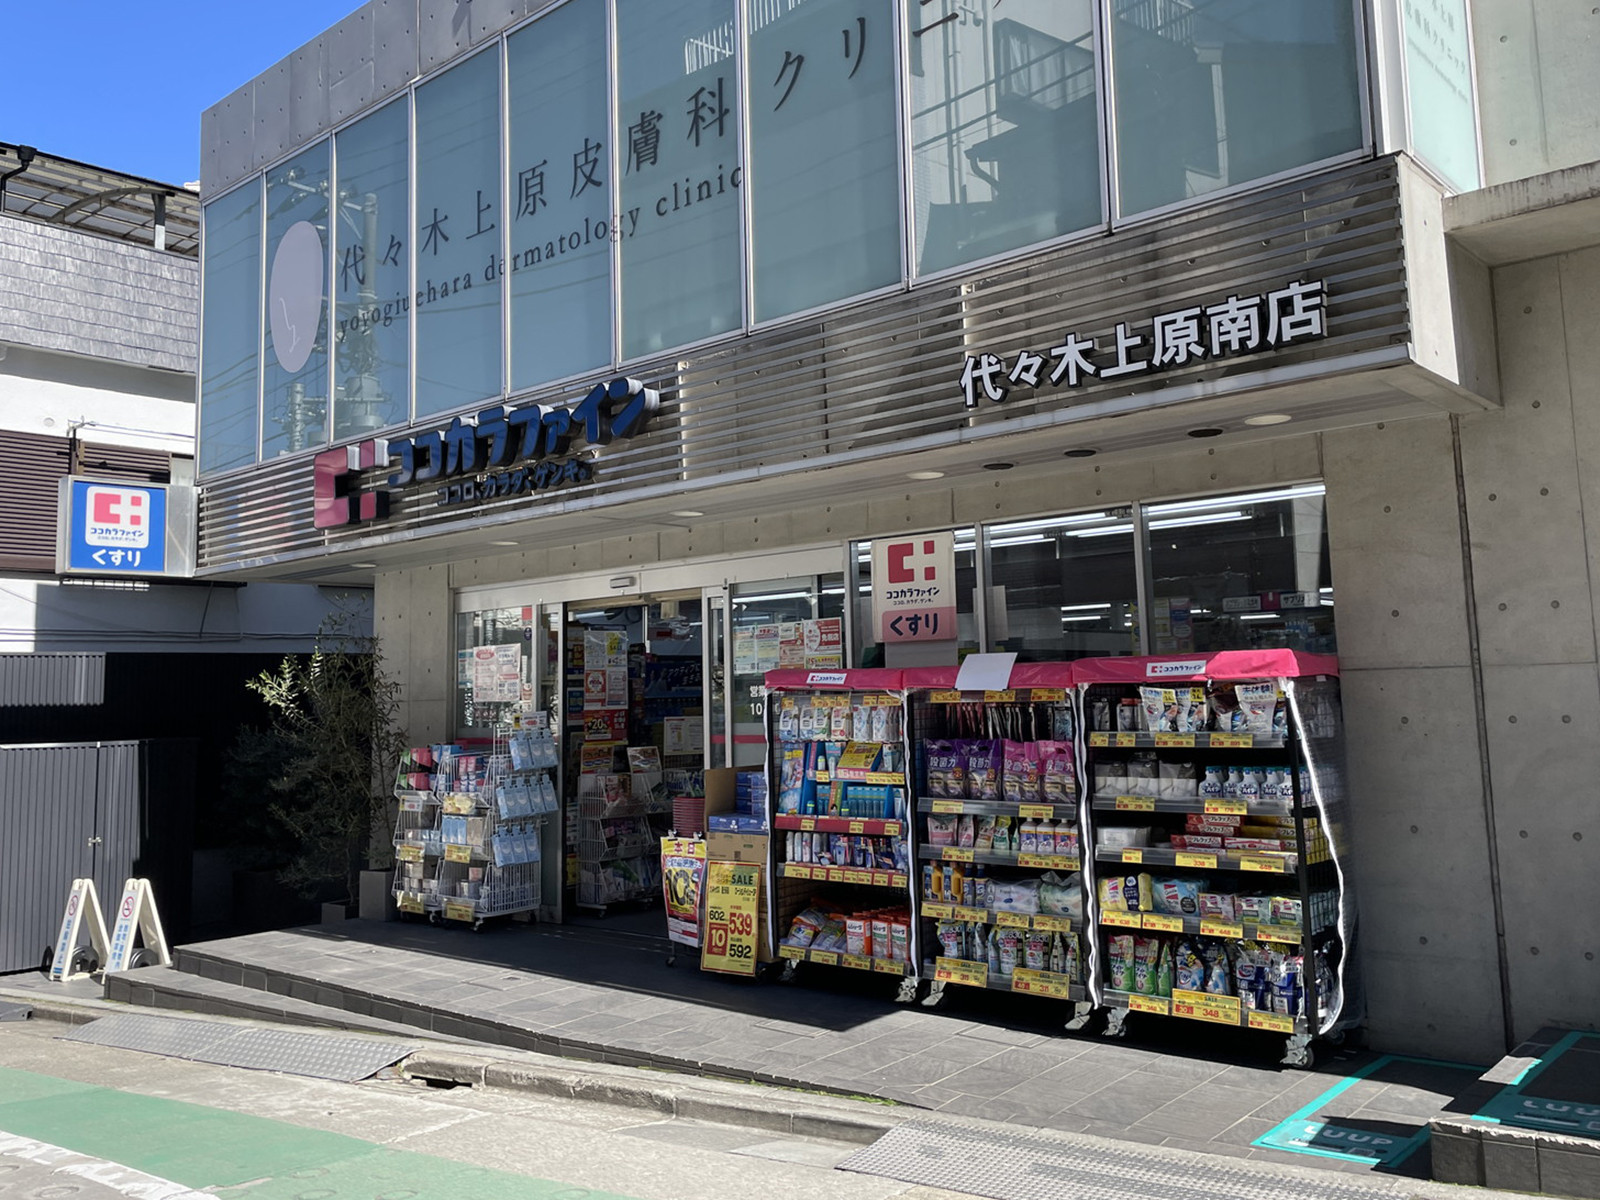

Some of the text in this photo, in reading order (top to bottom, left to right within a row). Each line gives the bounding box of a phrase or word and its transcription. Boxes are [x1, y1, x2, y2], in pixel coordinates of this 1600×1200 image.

[340, 272, 472, 343] yoyogiuehara
[655, 164, 741, 217] clinic
[959, 278, 1328, 408] 代々木上原南店
[387, 377, 652, 488] ココカラファイン
[90, 527, 144, 537] ココカラファイン
[92, 549, 141, 567] くすり
[886, 587, 940, 599] ココカラファイン
[890, 613, 938, 636] くすり
[1163, 664, 1202, 672] ココカラファイン
[731, 874, 754, 885] SALE
[709, 909, 725, 921] 602
[729, 912, 753, 937] 539
[711, 928, 726, 947] 10
[729, 943, 752, 959] 592
[1303, 1124, 1393, 1145] LUUP
